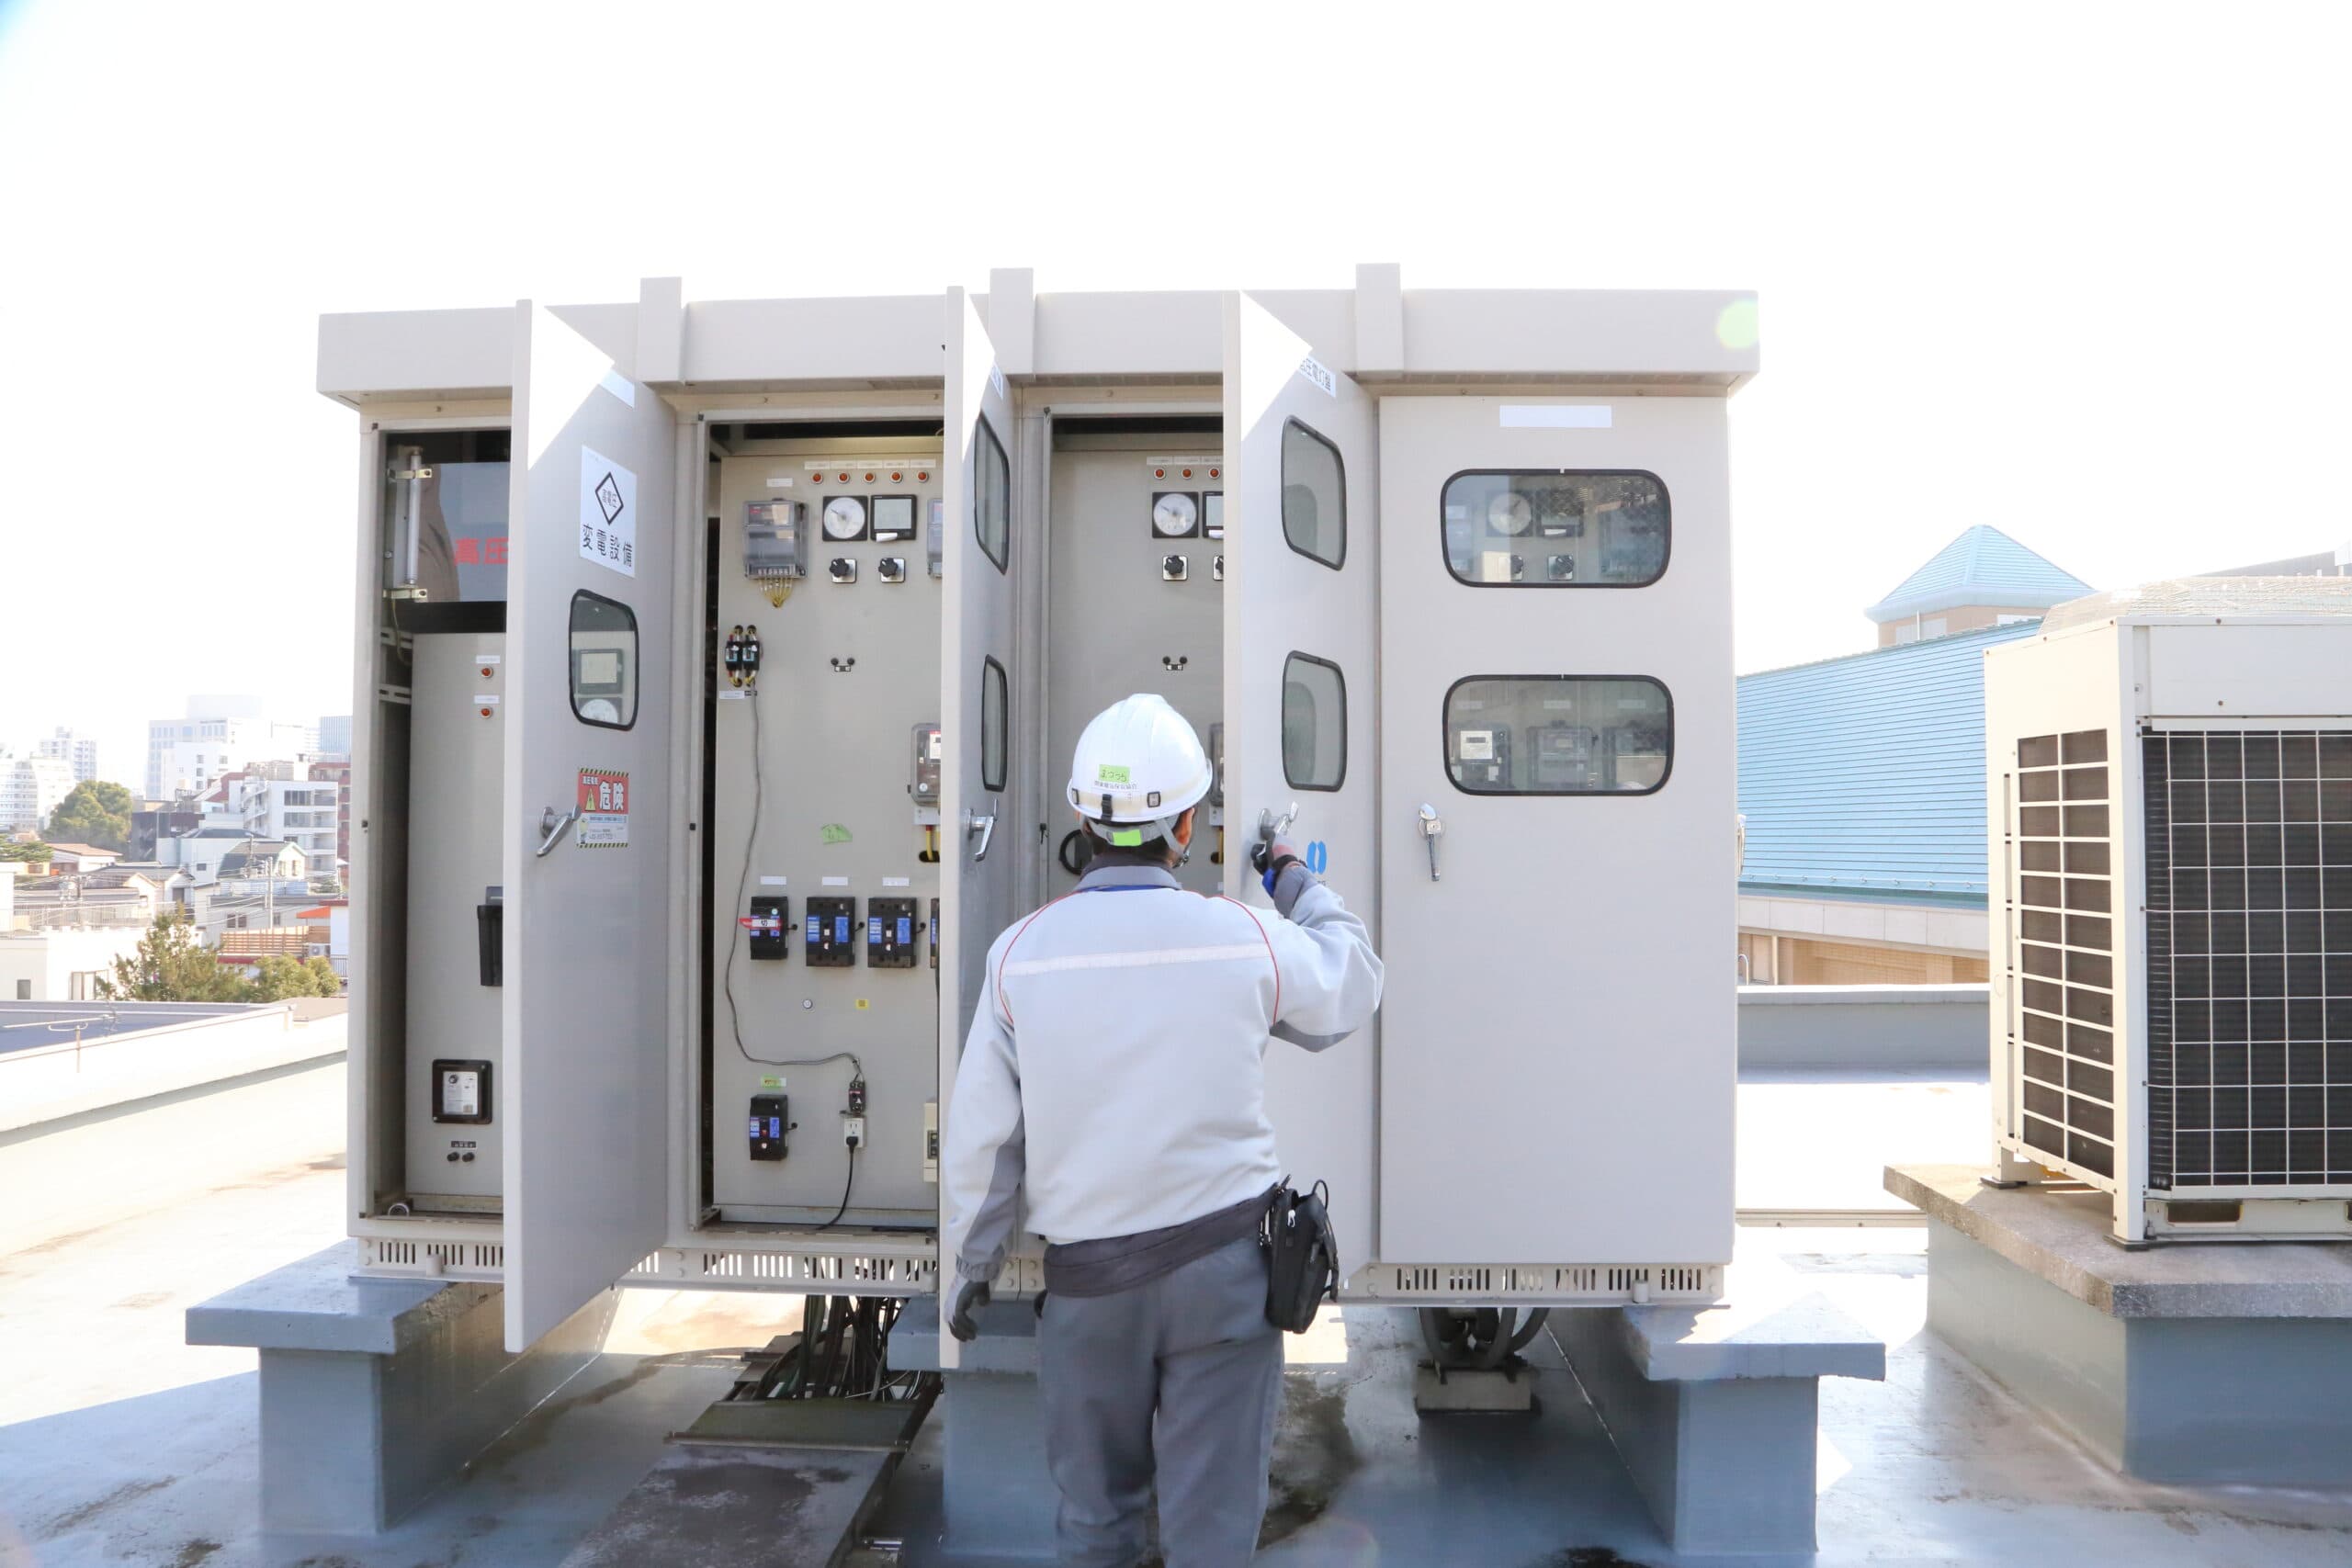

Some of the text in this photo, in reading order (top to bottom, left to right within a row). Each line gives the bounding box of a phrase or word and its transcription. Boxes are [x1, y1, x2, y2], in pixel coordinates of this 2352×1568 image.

[582, 523, 633, 568] 変電設備
[599, 780, 624, 811] 危険
